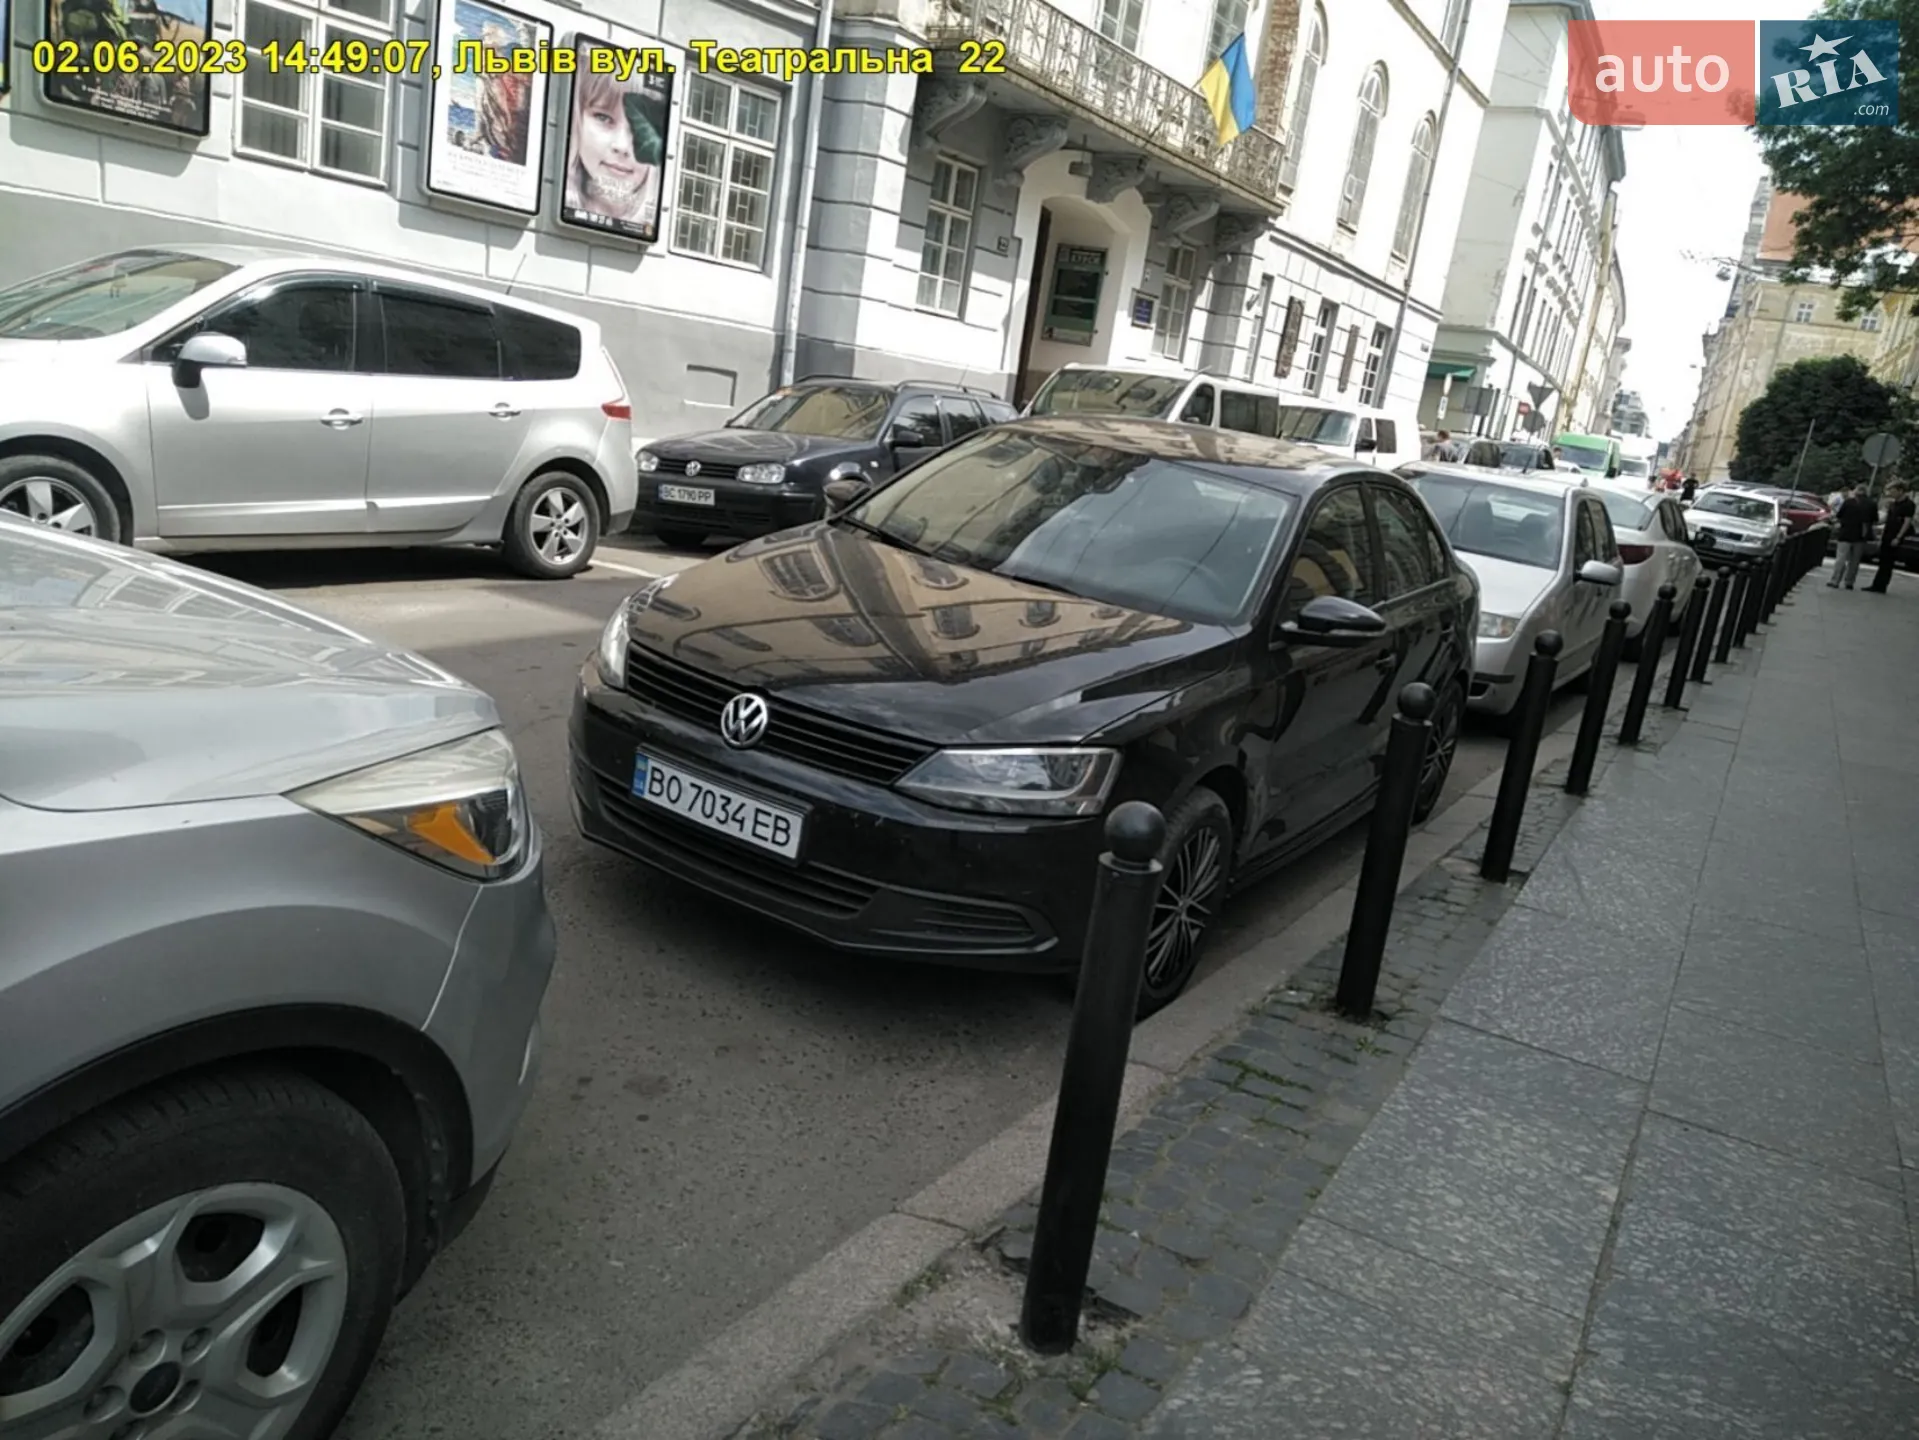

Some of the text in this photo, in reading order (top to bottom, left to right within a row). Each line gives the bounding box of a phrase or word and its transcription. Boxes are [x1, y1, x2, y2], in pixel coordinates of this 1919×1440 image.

[648, 766, 682, 804] BO
[688, 782, 746, 832] 7034
[751, 807, 791, 847] EB
